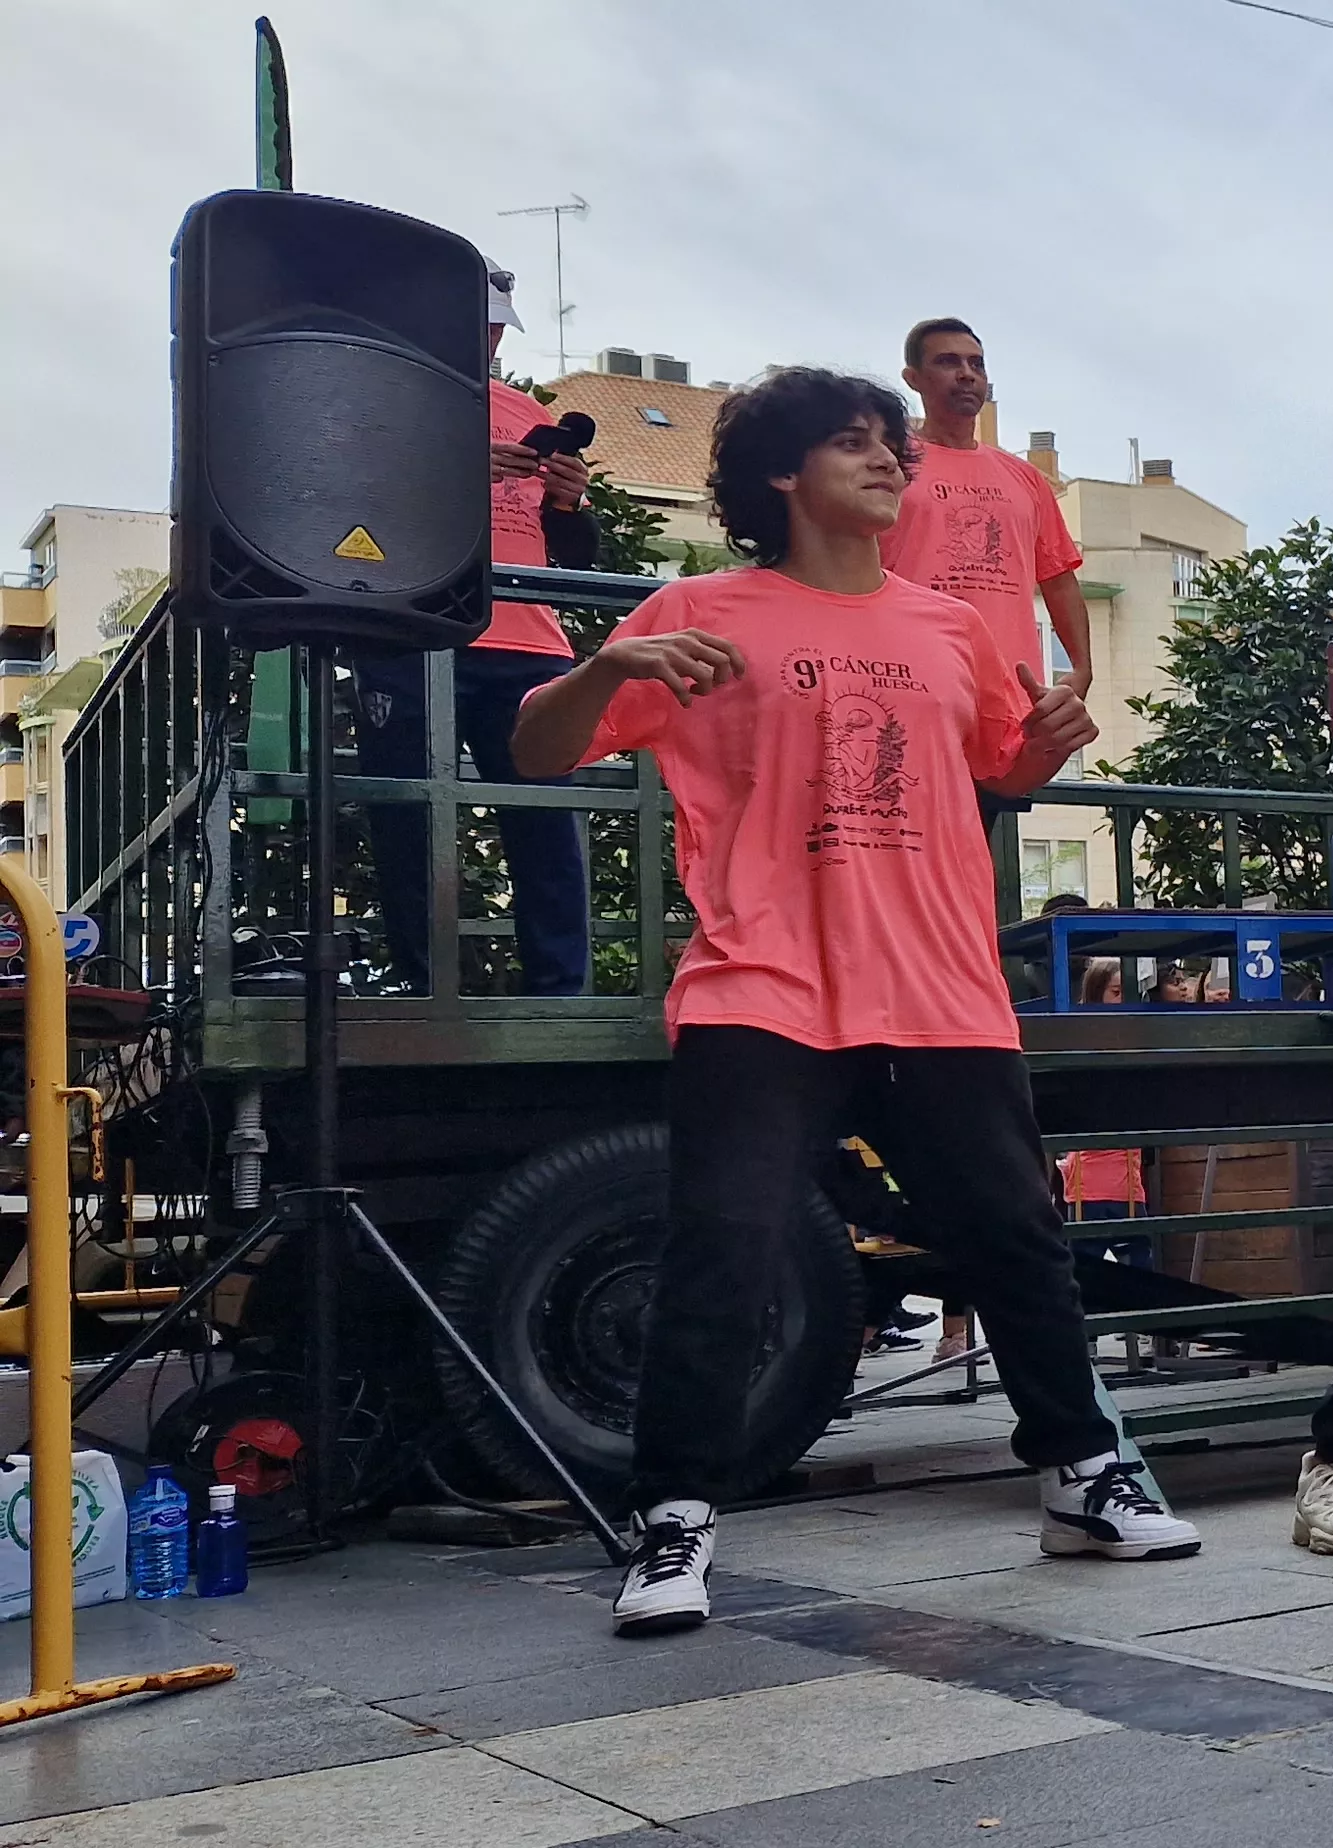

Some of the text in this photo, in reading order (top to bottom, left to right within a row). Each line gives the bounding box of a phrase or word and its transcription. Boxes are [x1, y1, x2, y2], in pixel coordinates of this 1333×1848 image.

[829, 655, 912, 680] CÁNCER
[871, 677, 930, 694] HUESCA
[1244, 939, 1275, 979] 3
